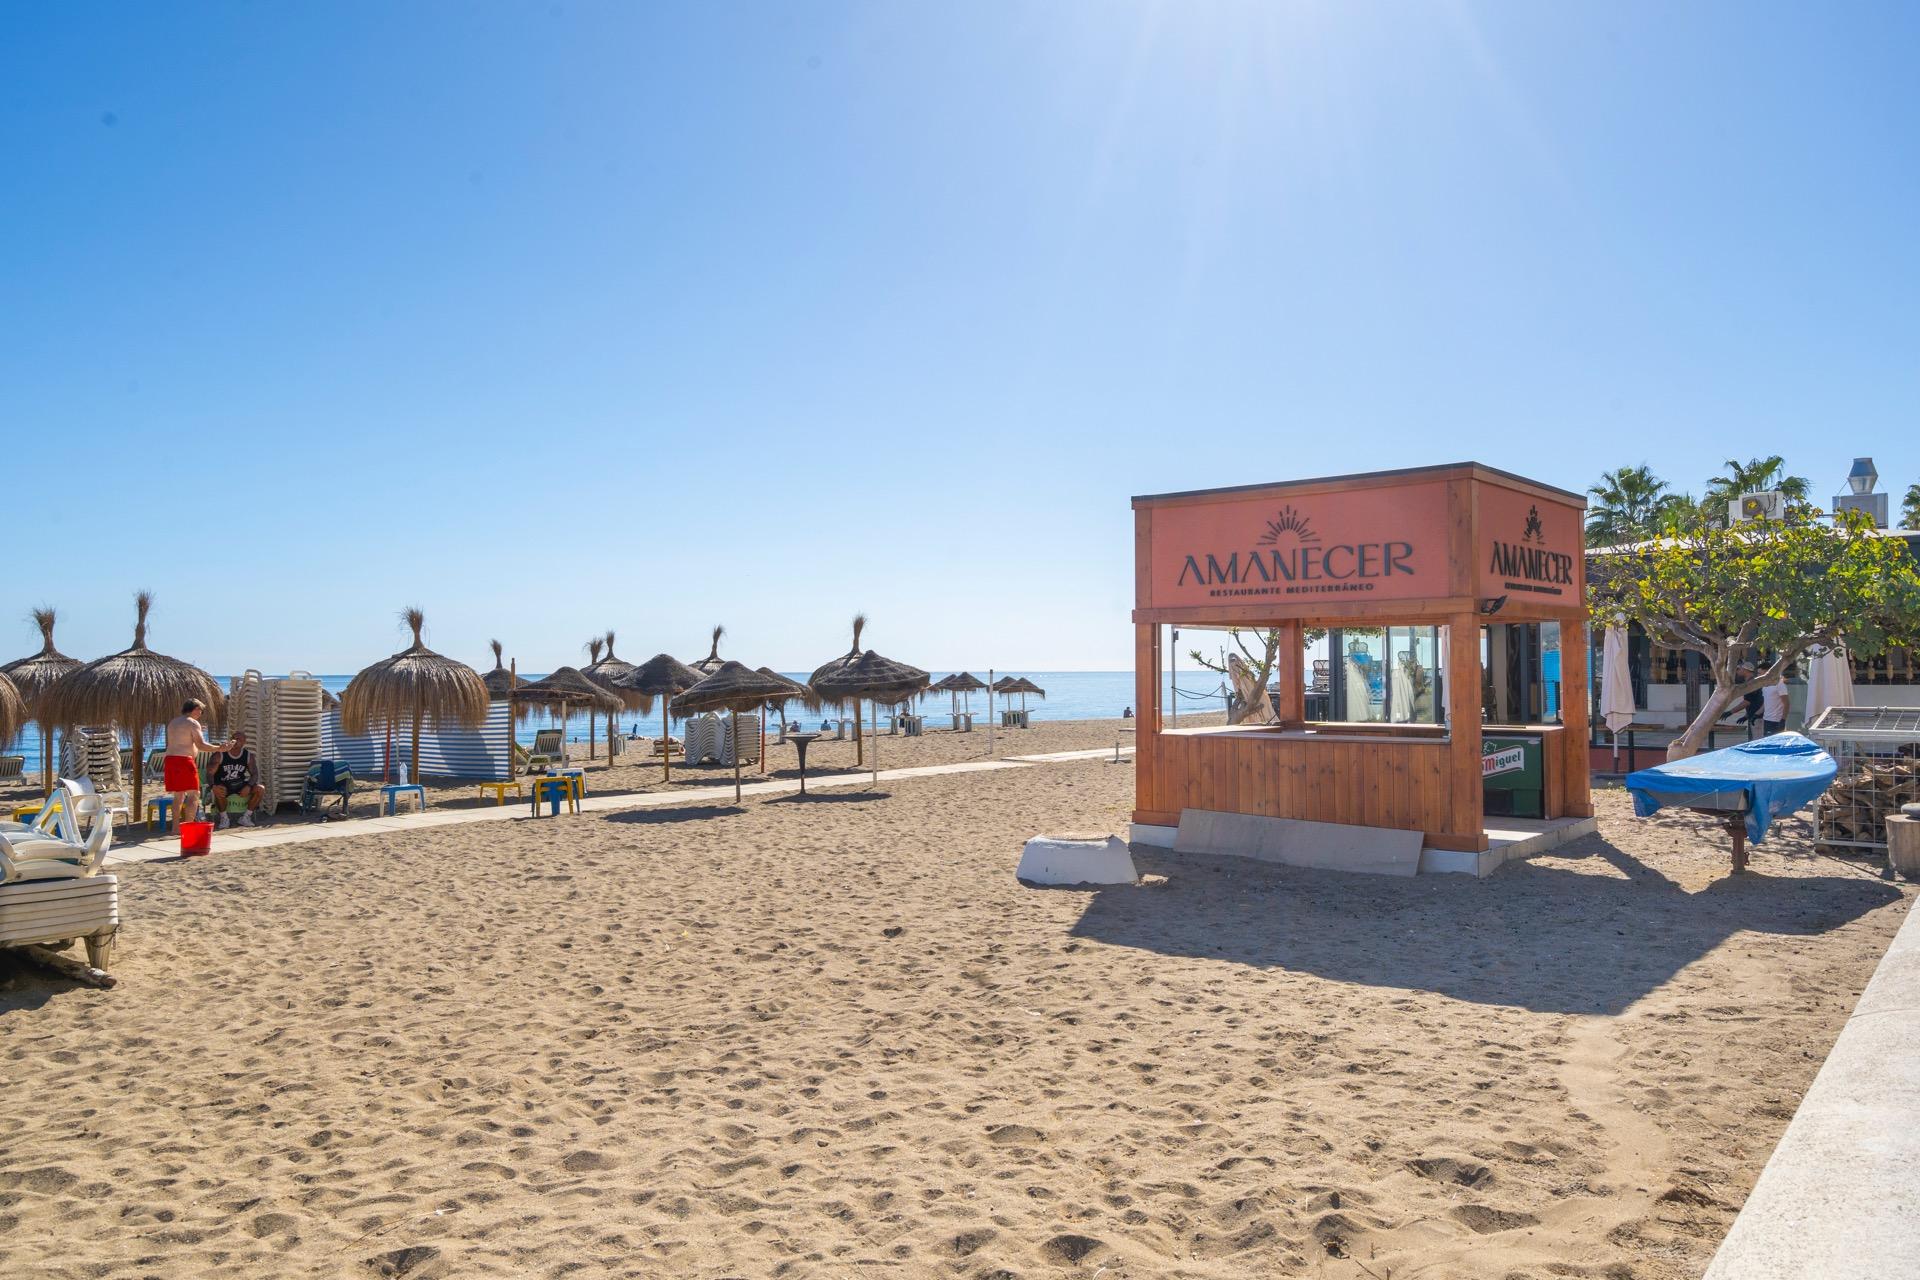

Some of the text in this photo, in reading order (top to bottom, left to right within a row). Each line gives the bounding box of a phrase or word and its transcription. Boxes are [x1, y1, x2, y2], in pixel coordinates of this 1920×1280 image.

[1177, 541, 1415, 586] AMANECER
[1490, 541, 1573, 585] AMANECER
[1210, 582, 1374, 597] RESTAURANTE MEDITERRÁNEO
[1484, 751, 1521, 771] Miguel
